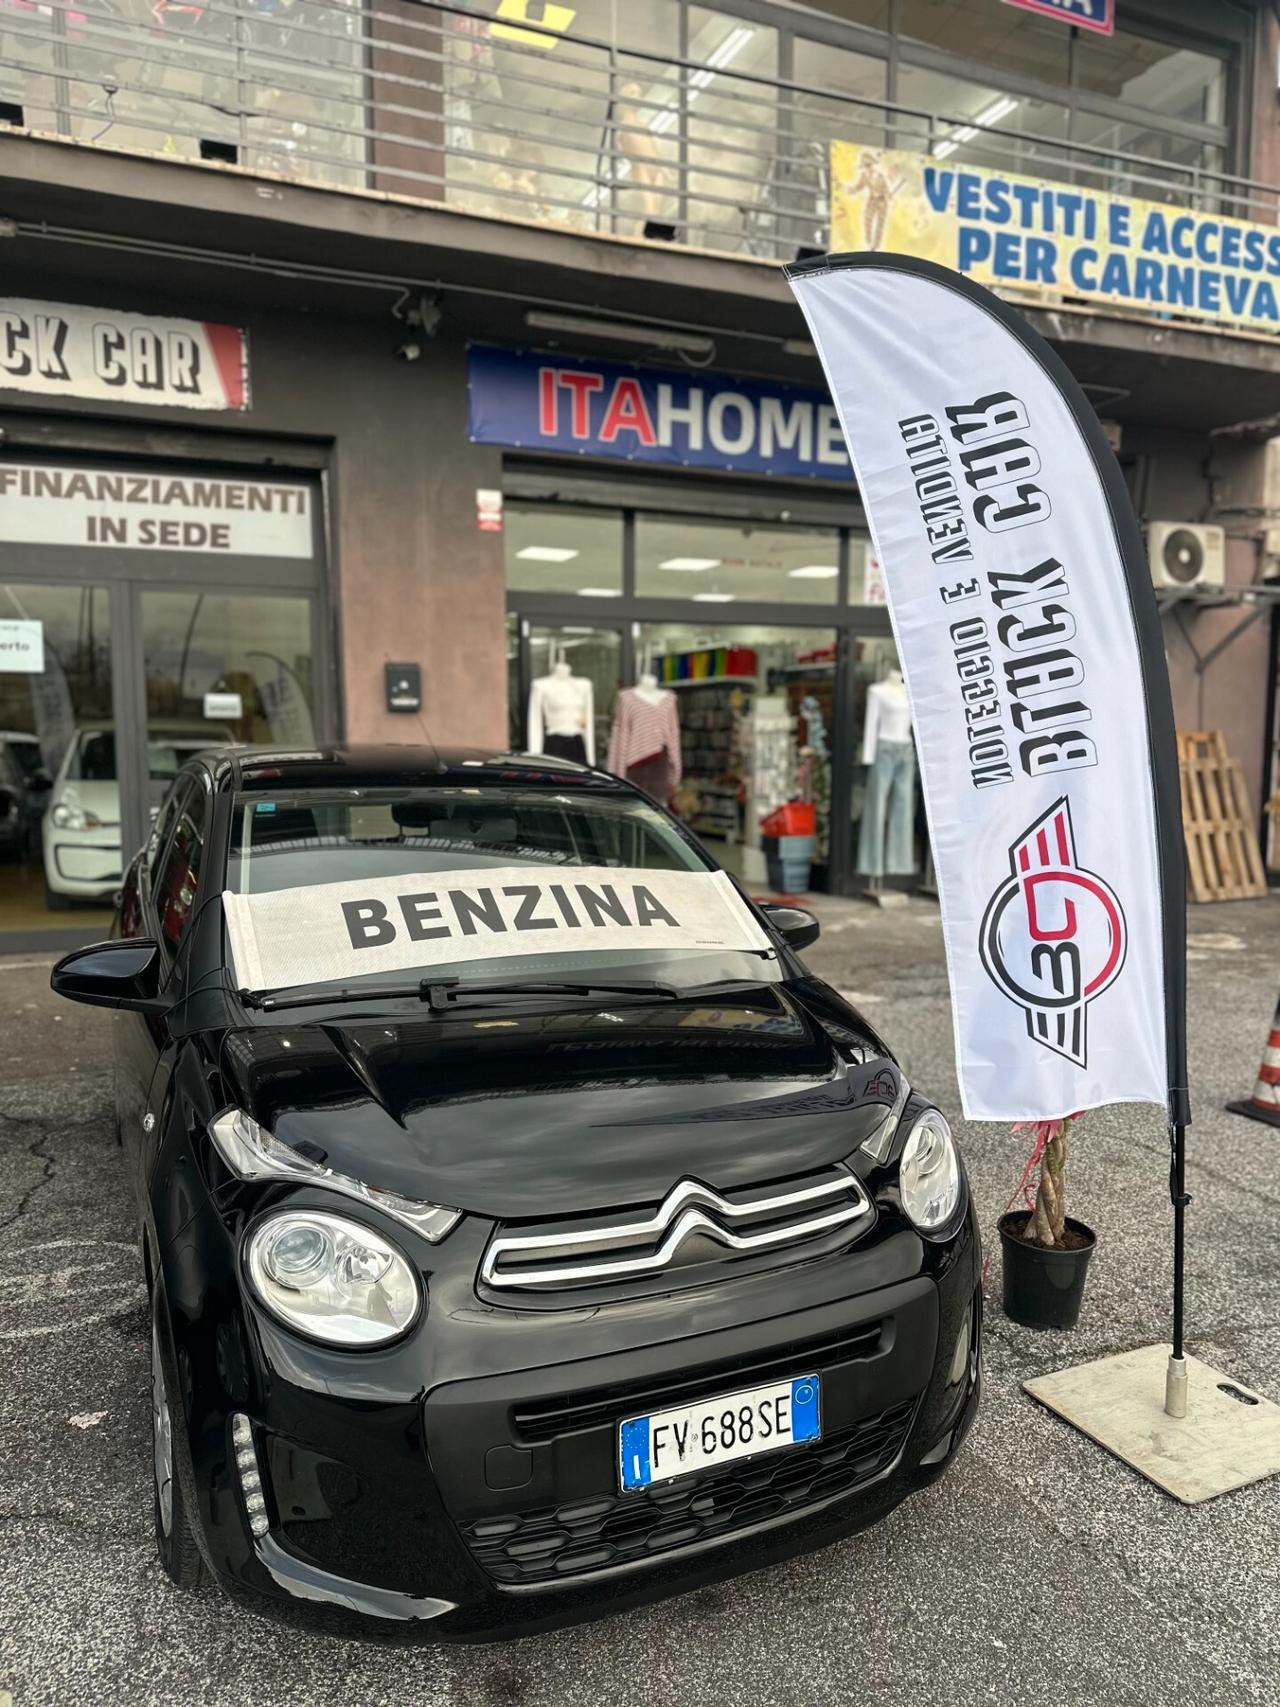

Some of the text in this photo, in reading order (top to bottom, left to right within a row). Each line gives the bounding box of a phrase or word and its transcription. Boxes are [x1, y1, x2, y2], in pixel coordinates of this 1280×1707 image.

[923, 167, 1097, 241] VESTITI
[1109, 203, 1130, 247] E
[958, 226, 1280, 321] PER CARNEVA
[92, 322, 202, 395] CAR
[539, 366, 849, 466] ITAHOME
[0, 468, 306, 515] FINANZIAMENTI
[87, 515, 231, 549] IN SEDE
[341, 884, 682, 950] BENZINA
[701, 1395, 791, 1455] 688SE
